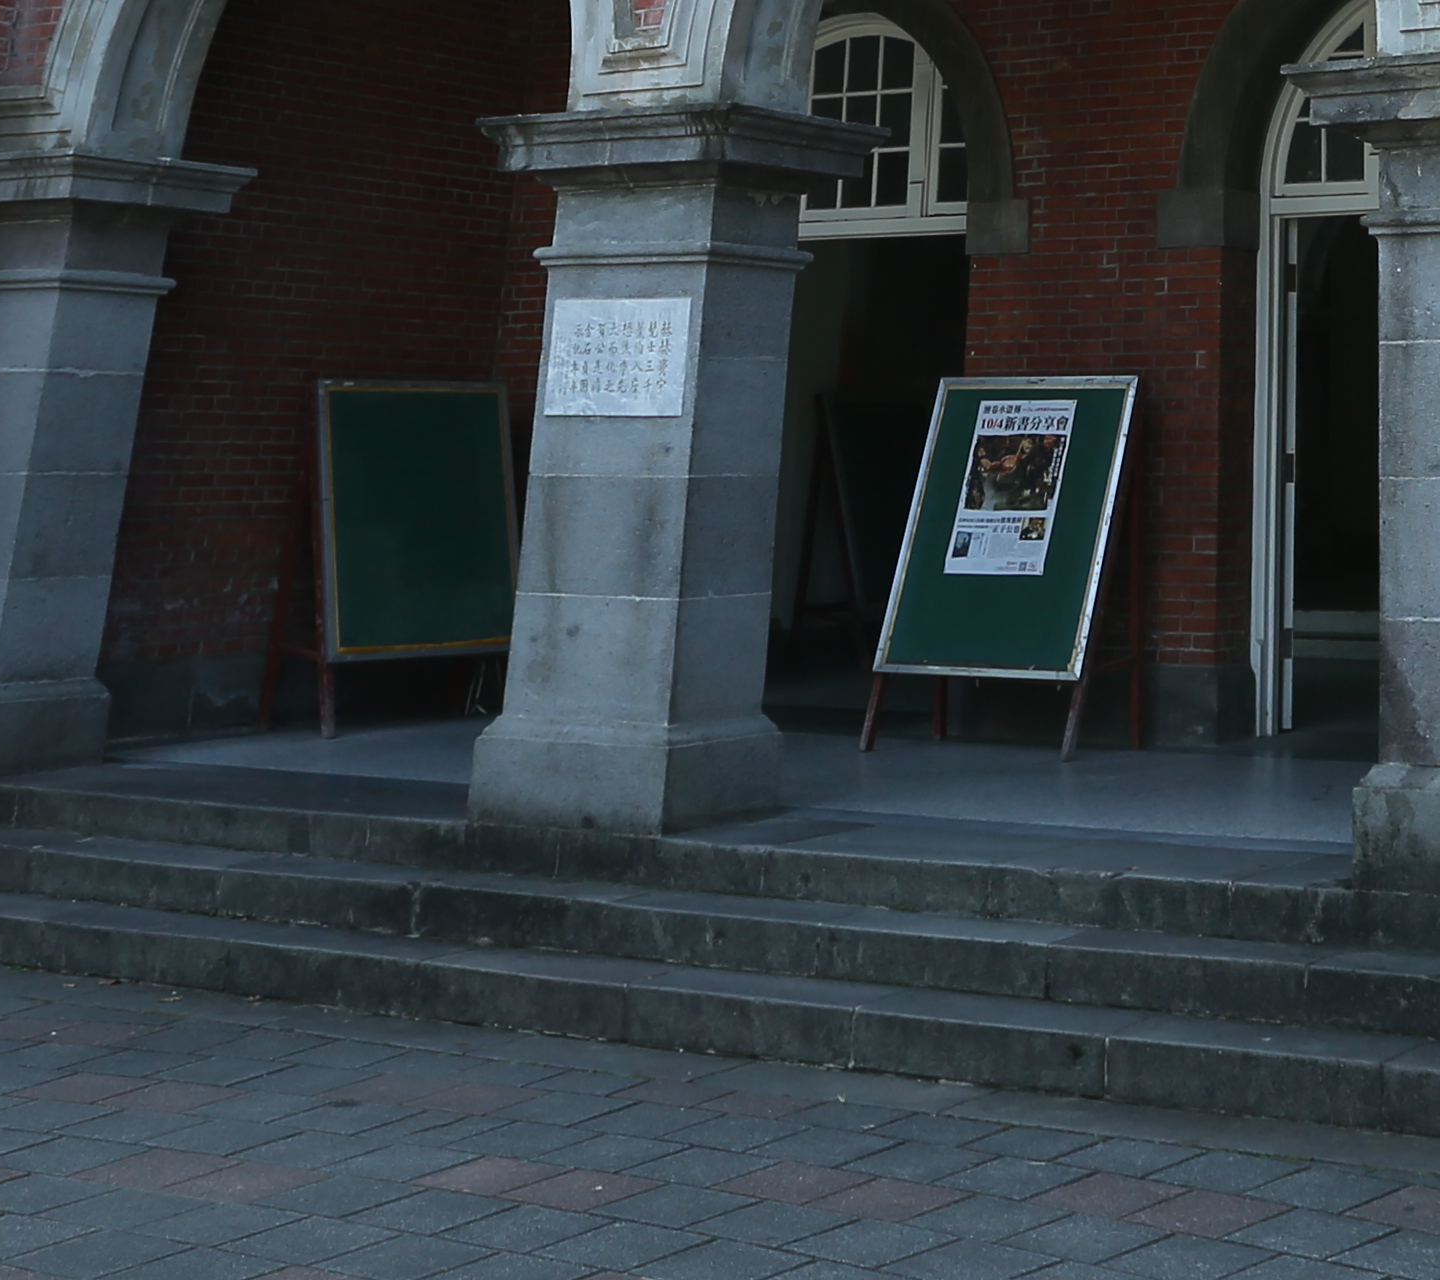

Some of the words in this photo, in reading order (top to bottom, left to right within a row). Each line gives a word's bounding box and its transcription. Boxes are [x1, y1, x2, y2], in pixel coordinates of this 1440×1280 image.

[981, 415, 1069, 431] 10/4新書分享會
